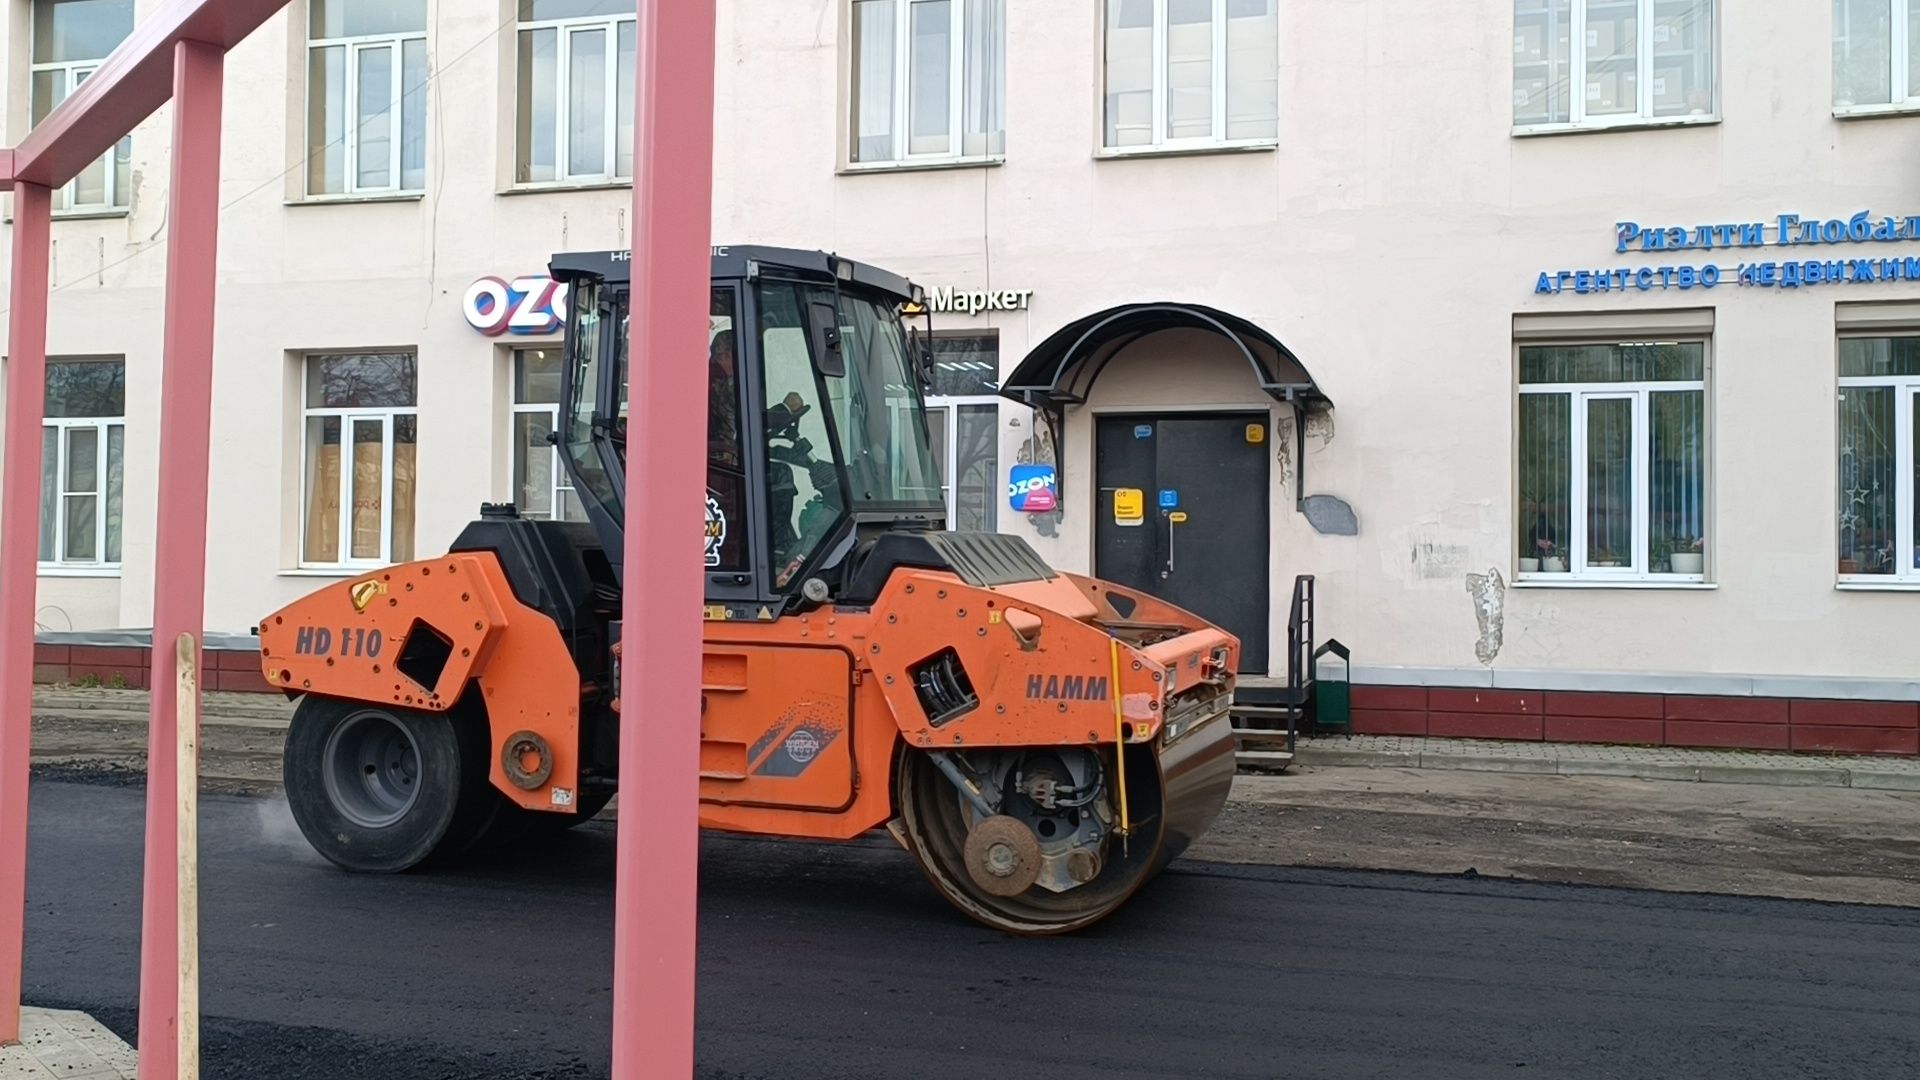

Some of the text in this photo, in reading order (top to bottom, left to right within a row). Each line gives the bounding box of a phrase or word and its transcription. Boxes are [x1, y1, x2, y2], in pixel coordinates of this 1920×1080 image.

[1615, 222, 1764, 252] Риэлти
[1535, 264, 1720, 295] АГЕНТСТВО
[931, 286, 1031, 315] Маркет
[1008, 472, 1055, 497] OZON
[295, 626, 382, 658] HD 110
[1025, 674, 1107, 701] HAMM
